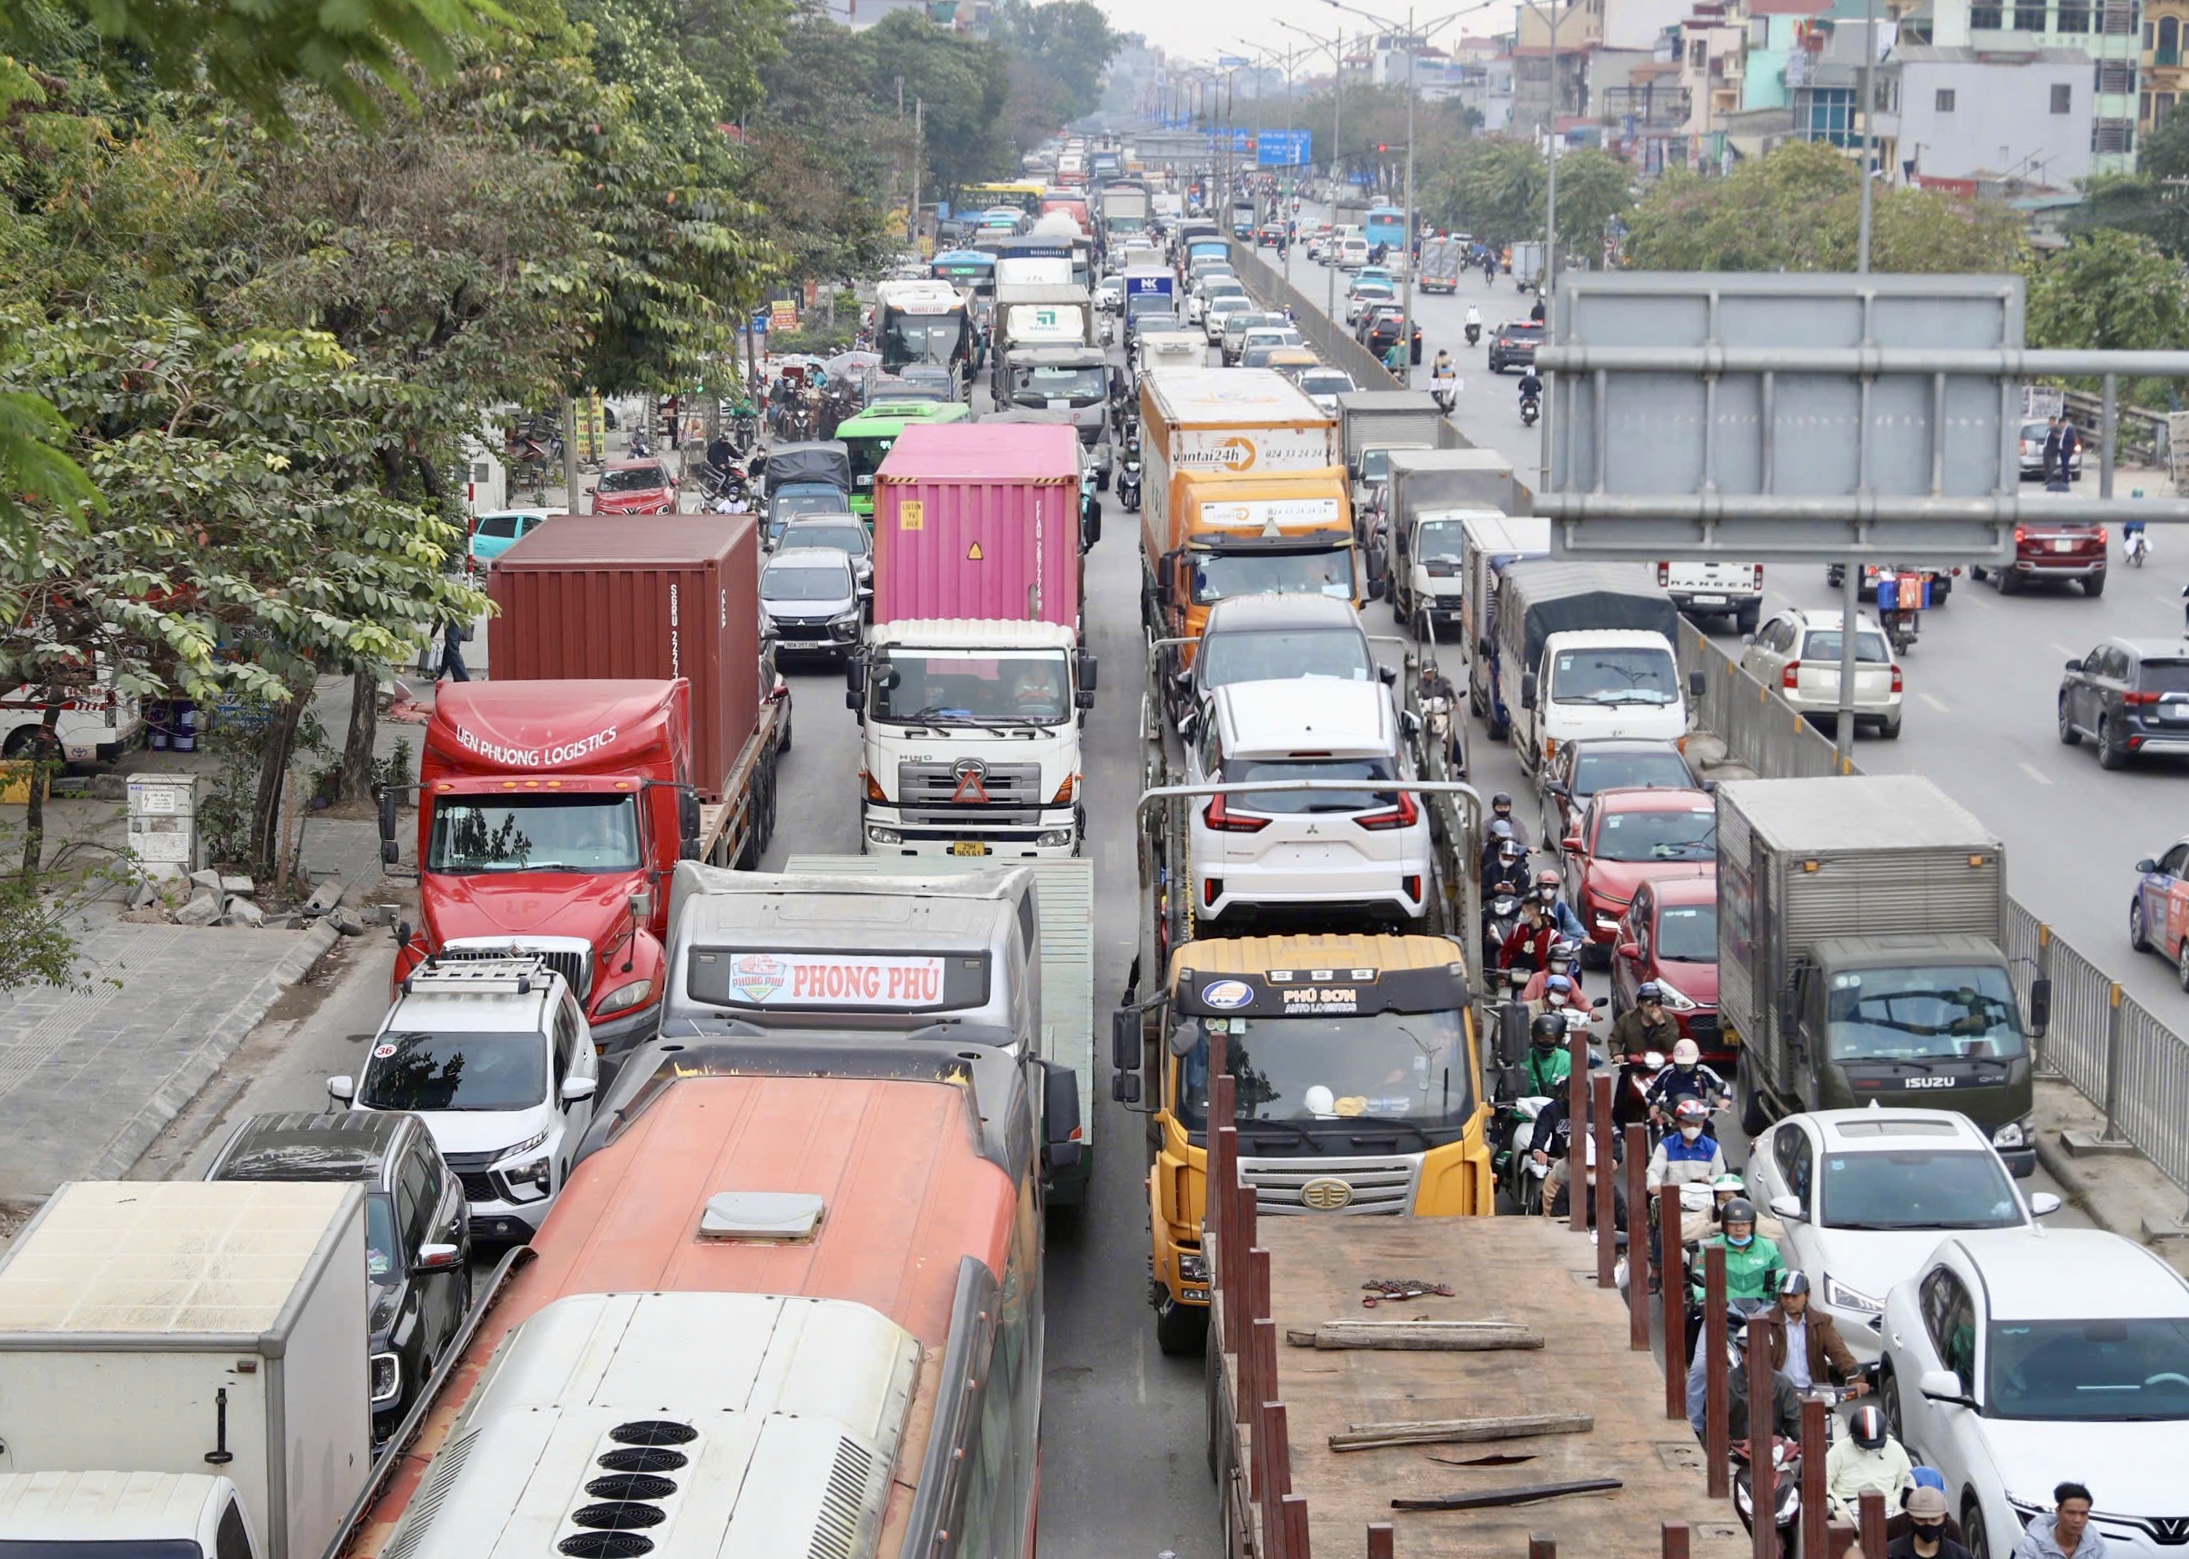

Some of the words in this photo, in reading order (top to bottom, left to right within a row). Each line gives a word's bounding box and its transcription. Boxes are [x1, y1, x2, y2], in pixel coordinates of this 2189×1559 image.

[1670, 580, 1752, 588] RANGER
[480, 740, 539, 767] PHUONG
[544, 725, 617, 766] LOGISTICS
[899, 754, 933, 762] HINO
[792, 965, 881, 999] PHONG
[887, 958, 940, 1001] PHÚ
[1283, 987, 1317, 1004] PHÚ
[1285, 1002, 1311, 1014] AUTO
[1313, 1002, 1357, 1013] LOGISTICS
[377, 1046, 393, 1055] 36
[1904, 1076, 1956, 1089] ISUZU
